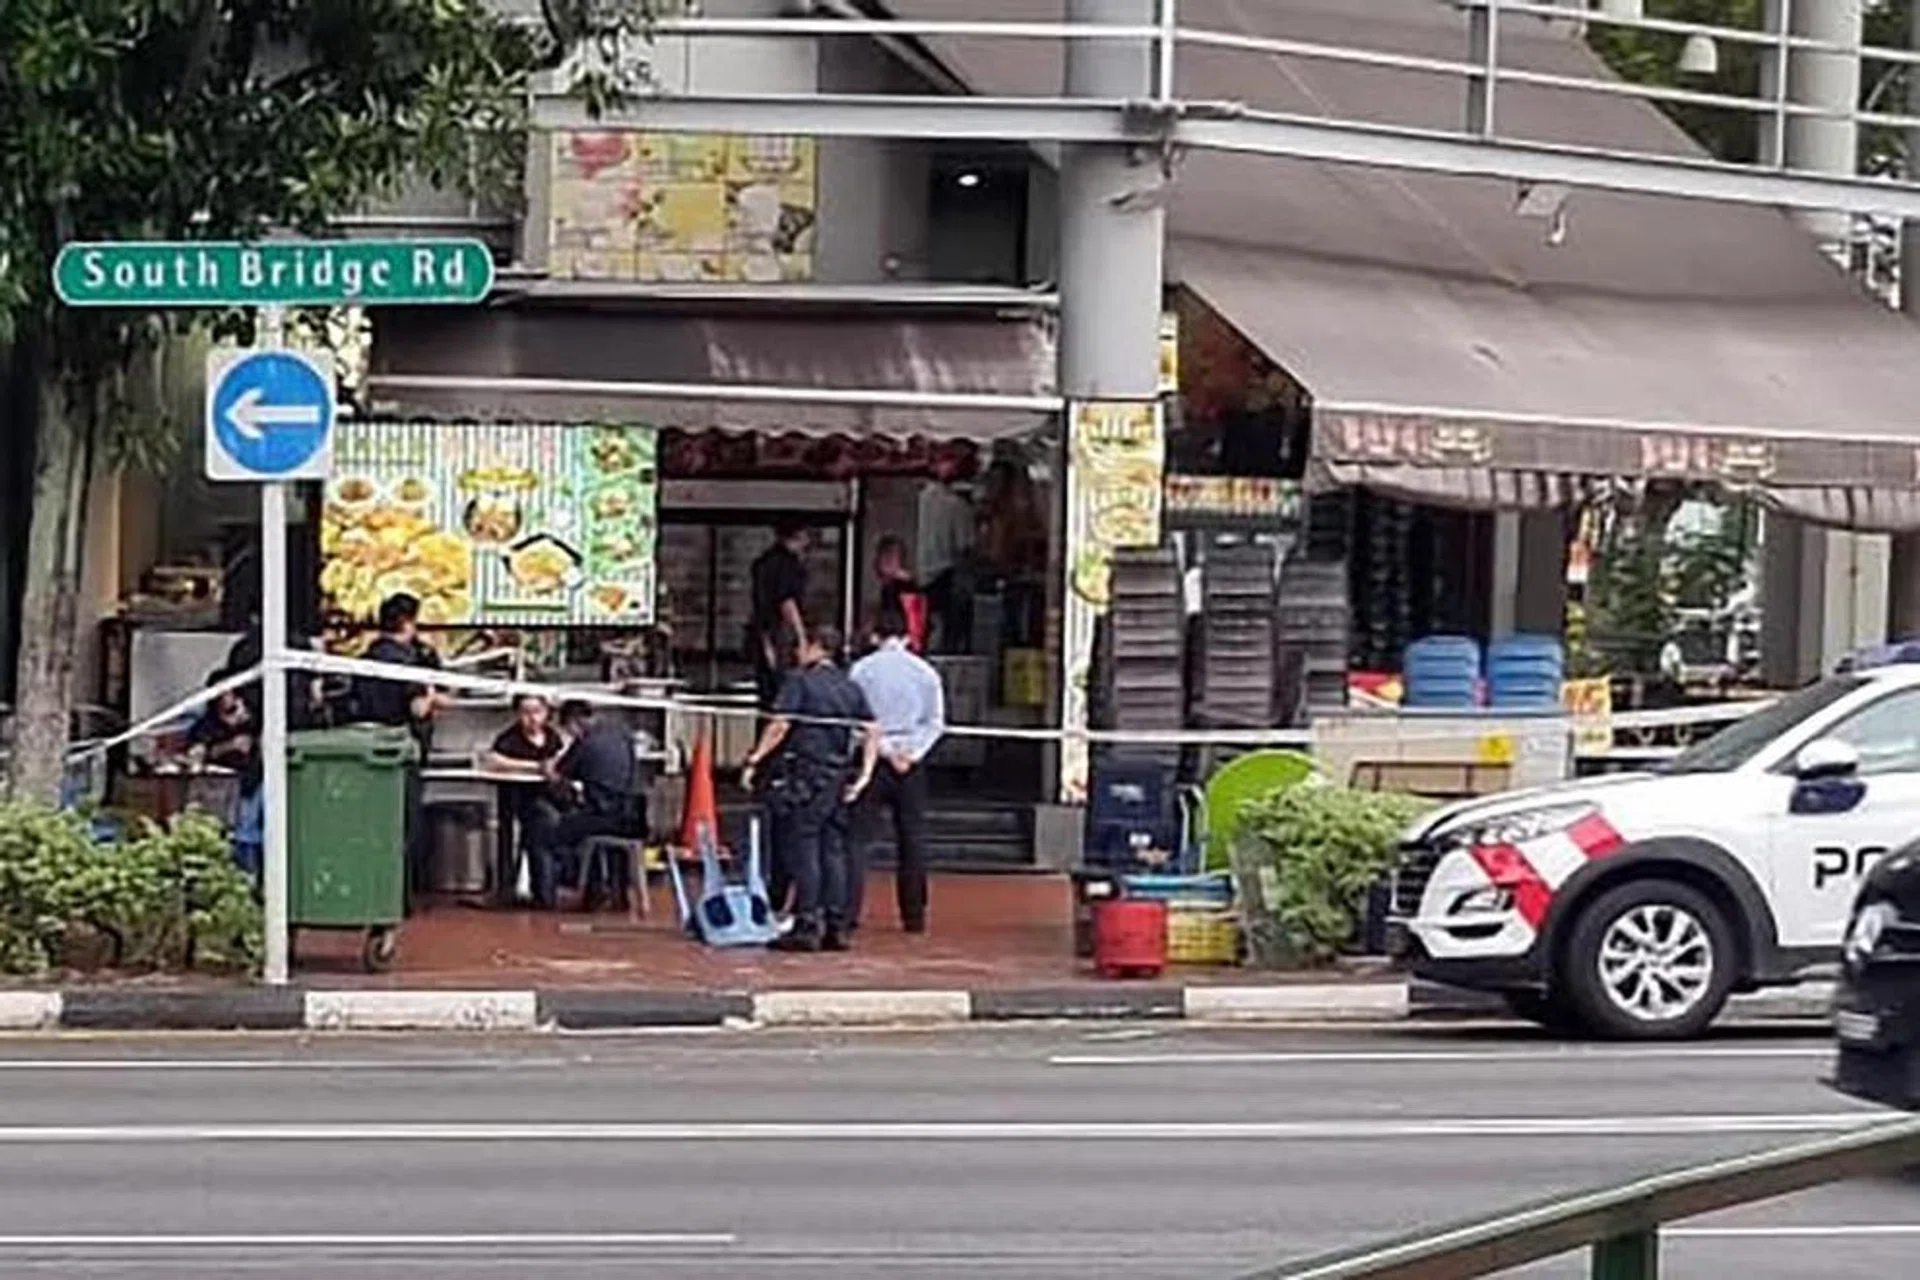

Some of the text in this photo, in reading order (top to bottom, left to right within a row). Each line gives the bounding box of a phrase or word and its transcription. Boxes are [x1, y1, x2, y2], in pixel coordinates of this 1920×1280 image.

[83, 248, 466, 296] South Bridge Rd
